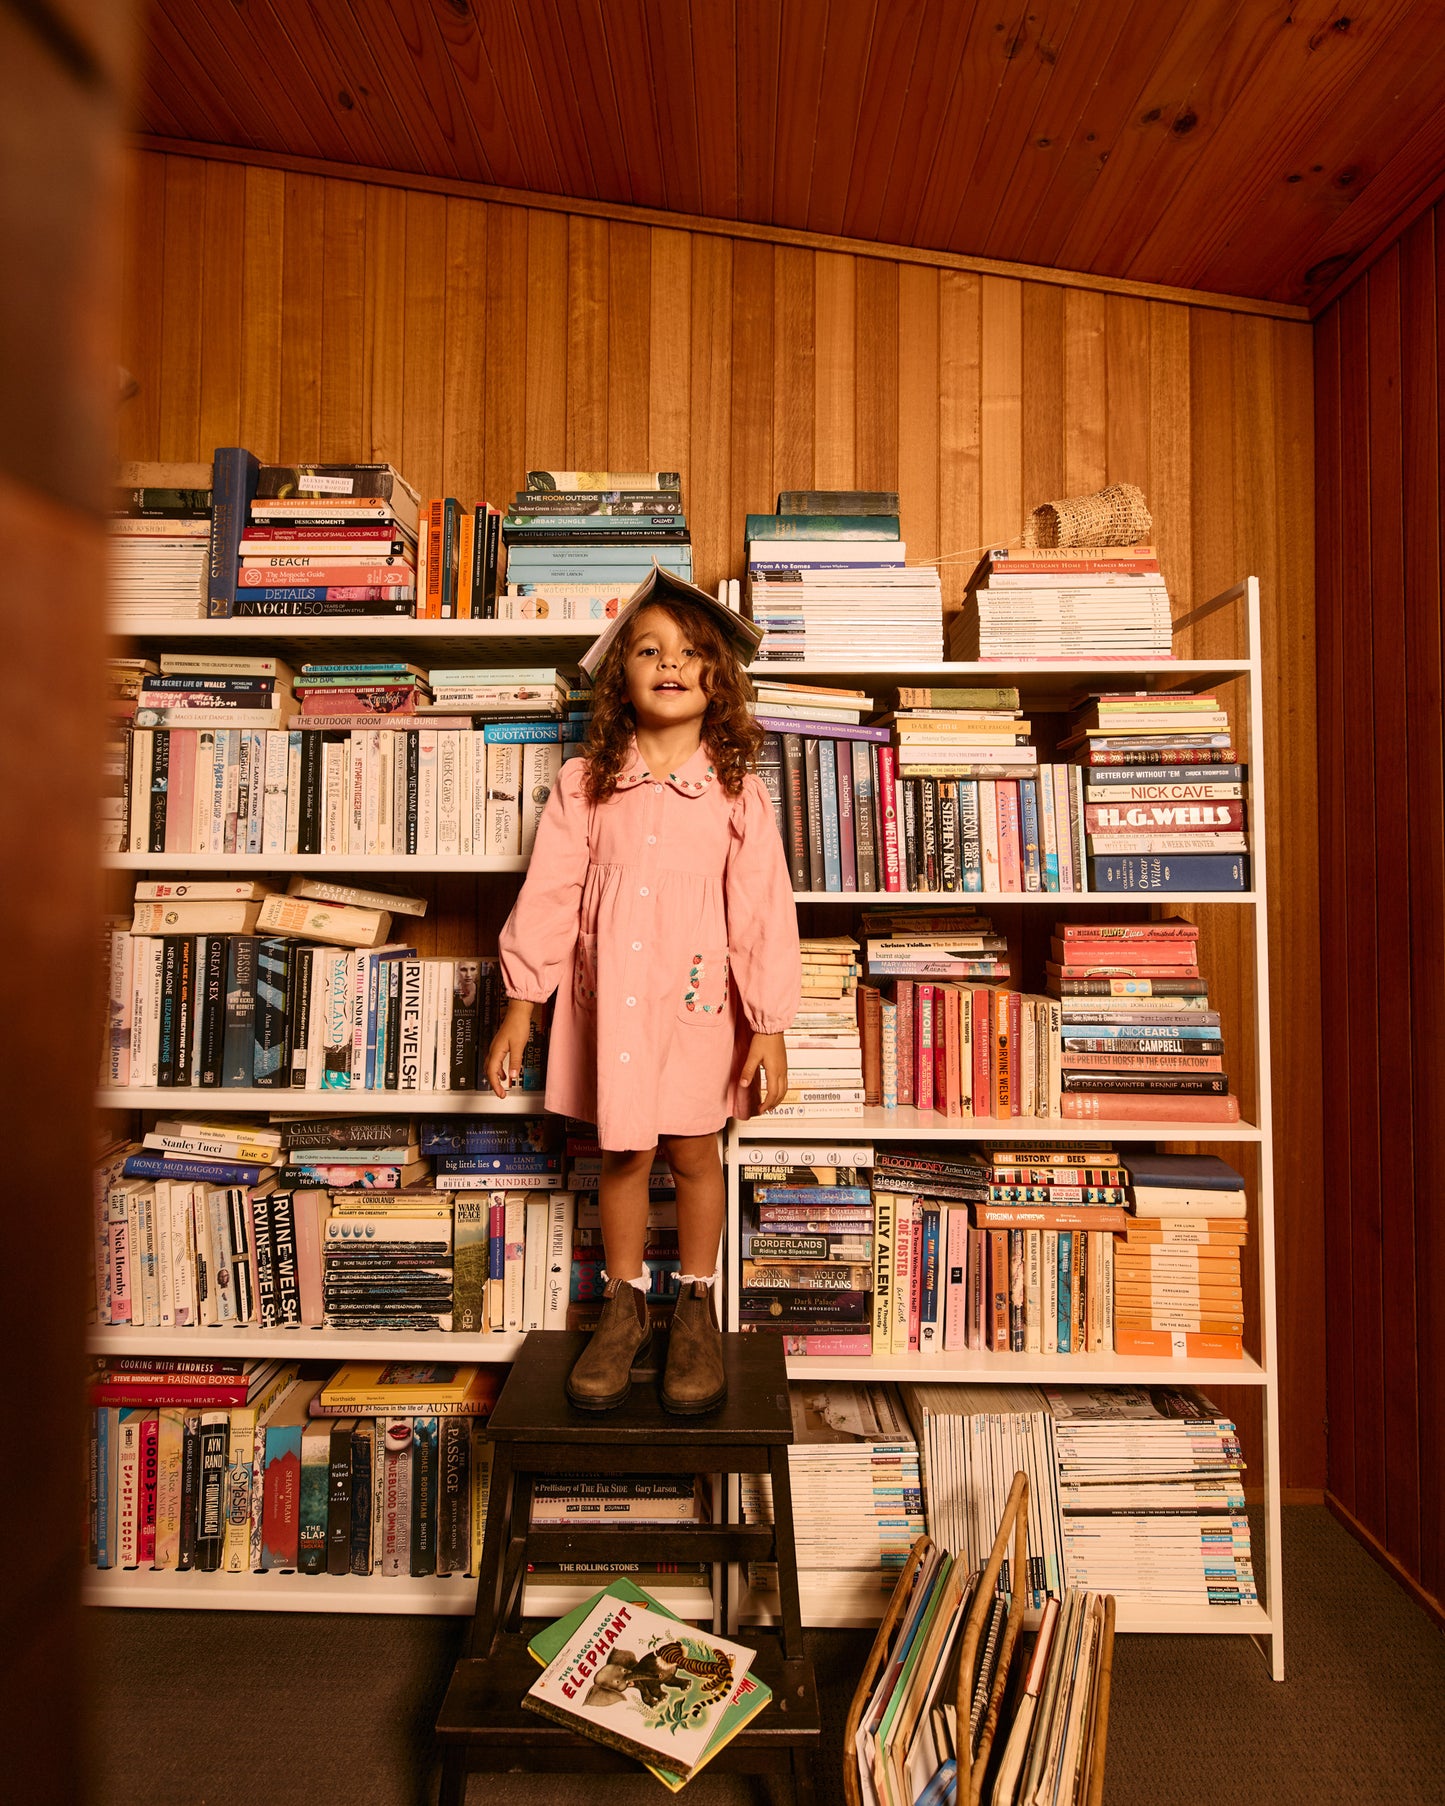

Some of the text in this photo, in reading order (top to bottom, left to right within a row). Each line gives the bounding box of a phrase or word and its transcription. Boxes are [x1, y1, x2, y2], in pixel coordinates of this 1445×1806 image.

[270, 558, 310, 566] BEACH
[265, 589, 315, 600] DETAILS
[314, 716, 351, 726] OUTDOOR
[386, 717, 411, 725] JAMIE
[488, 730, 557, 741] QUOTATIONS
[842, 775, 850, 817] sunbathing
[858, 752, 868, 837] HANNAH KENT
[1131, 786, 1213, 798] NICK CAVE
[792, 770, 803, 857] ALMOST CHIMPANZEE
[962, 793, 978, 838] PATTERSON
[885, 822, 898, 872] WETLANDS
[942, 802, 955, 878] STEPHEN KING
[1139, 858, 1148, 888] Oscar
[1152, 858, 1160, 888] Wilde
[315, 884, 356, 896] JASPER
[209, 942, 221, 1000] GREAT SEX
[237, 942, 250, 984] LARSSON
[162, 947, 174, 1062] NEVER ALONE ELIZABETH HAYNES
[333, 960, 345, 1043] SAGA LAND
[402, 961, 420, 1089] IRVINE WELSH
[456, 1019, 464, 1065] GARDENIA
[1121, 1040, 1182, 1052] BRUCE CAMPBELL
[999, 996, 1009, 1106] Trainspotting IRVINE WELSH
[291, 1124, 322, 1134] GAME
[350, 1131, 391, 1140] MARTIN
[161, 1138, 222, 1153] Stanley Tucci
[241, 1150, 257, 1158] Taste
[446, 1160, 489, 1169] big little lies
[882, 1157, 983, 1176] BLOOD MONEY Arden Winch
[1016, 1154, 1050, 1163] HISTORY
[1054, 1155, 1064, 1163] OF
[1067, 1155, 1086, 1163] BEES
[495, 1178, 540, 1186] KINDRED
[763, 1173, 786, 1181] MOVIES
[877, 1178, 914, 1188] sleepers
[458, 1211, 480, 1219] PEACE
[329, 1224, 375, 1238] glue
[553, 1202, 564, 1257] NAOMI CAMPBELL
[754, 1240, 822, 1249] BORDERLANDS
[878, 1206, 890, 1296] LILY ALLEN
[898, 1219, 911, 1276] ZOË FOSTER
[114, 1229, 124, 1296] Nick Hornby
[273, 1194, 297, 1324] IRVINE WELSH
[755, 1270, 781, 1278] CONN
[814, 1271, 847, 1280] WOLF OF
[809, 1280, 851, 1288] THE PLAINS
[550, 1280, 563, 1311] Swan
[813, 1298, 836, 1306] Palace
[120, 1360, 214, 1372] COOKING WITH KINDNESS
[208, 1439, 221, 1451] AYN
[205, 1454, 222, 1468] RAND
[447, 1429, 458, 1493] PASSAGE
[168, 1450, 179, 1531] The Rice Mother
[284, 1470, 293, 1523] SHANTARAM
[205, 1483, 219, 1534] FOUNTAINHEAD
[301, 1532, 325, 1540] SLAP
[558, 1613, 614, 1683] THE SAGGY BAGGY
[561, 1607, 632, 1699] ELEPHANT
